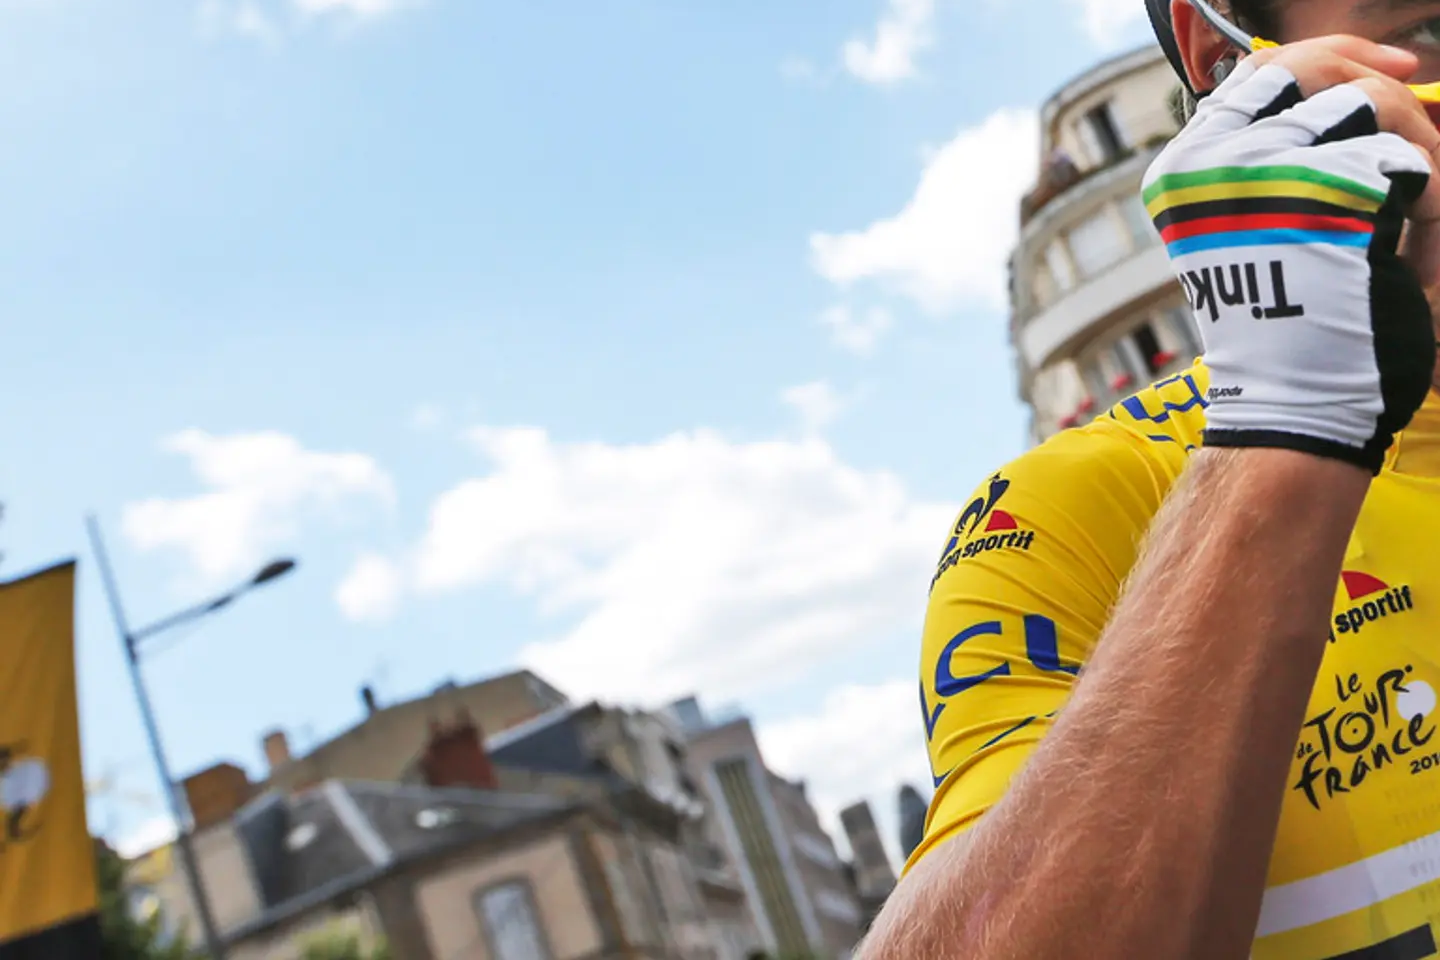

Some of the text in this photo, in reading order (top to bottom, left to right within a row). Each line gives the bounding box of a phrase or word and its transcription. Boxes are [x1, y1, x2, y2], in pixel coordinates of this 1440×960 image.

[1179, 260, 1304, 323] Tink
[962, 530, 1035, 559] sportif
[1334, 585, 1414, 634] sportif
